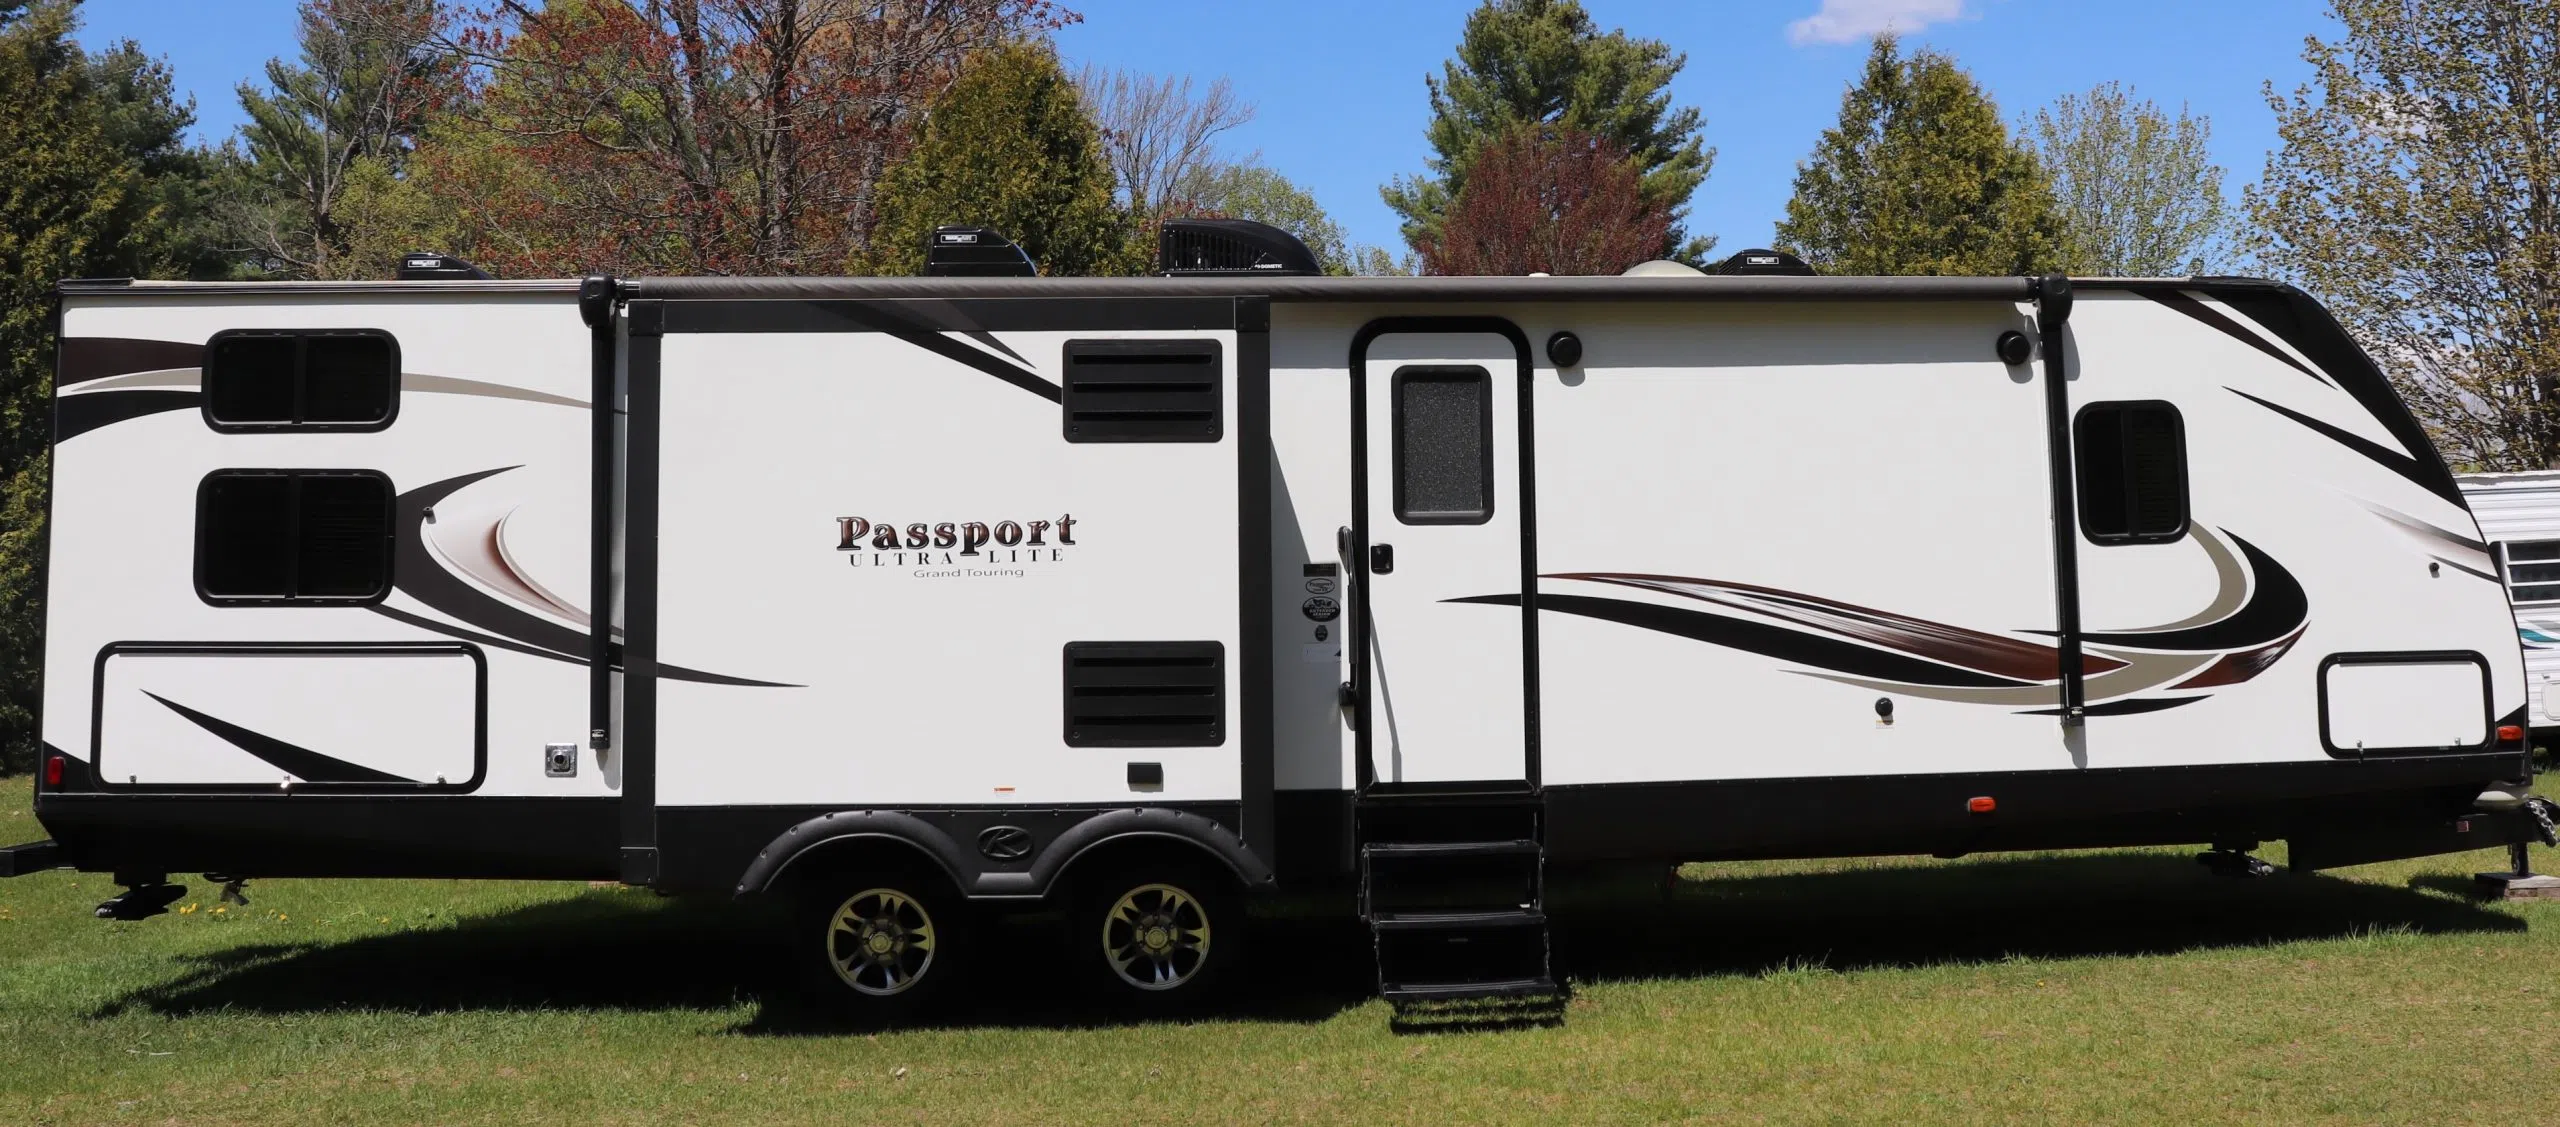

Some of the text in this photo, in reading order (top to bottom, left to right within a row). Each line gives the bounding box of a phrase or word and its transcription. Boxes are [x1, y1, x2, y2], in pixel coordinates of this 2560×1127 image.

[836, 513, 1077, 556] Passport
[849, 548, 1064, 567] ULTRA LITE
[913, 568, 1025, 578] Grand Touring
